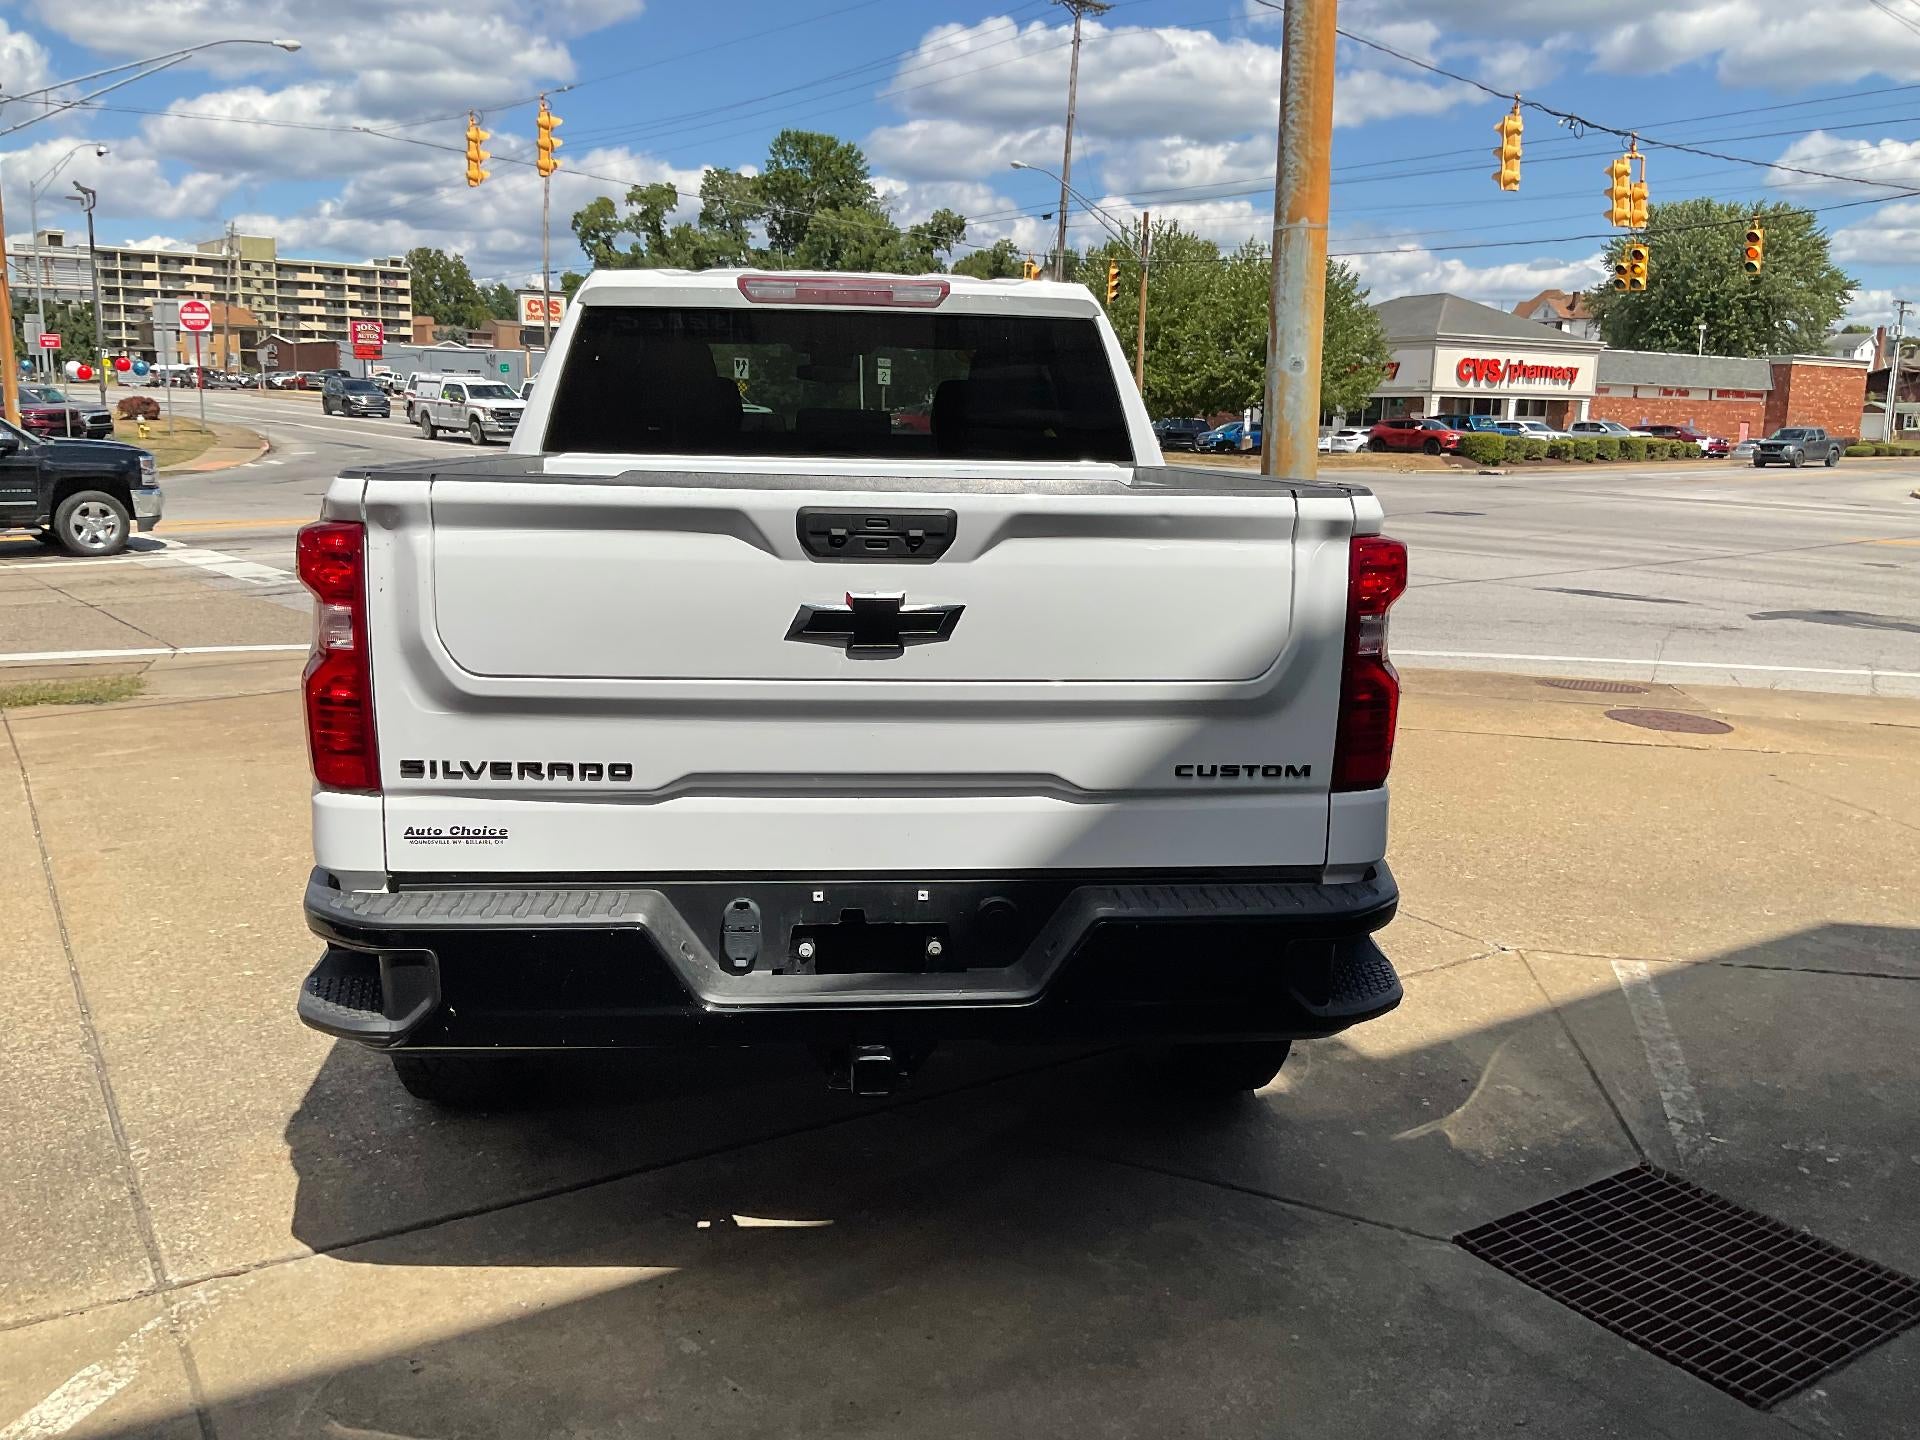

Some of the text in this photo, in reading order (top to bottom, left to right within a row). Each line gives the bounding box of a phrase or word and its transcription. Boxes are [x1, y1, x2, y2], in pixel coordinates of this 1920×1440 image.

[355, 323, 381, 333] JOE'S
[400, 759, 633, 781] SILVERADO
[1174, 764, 1312, 777] CUSTOM
[403, 825, 509, 836] Auto Choice
